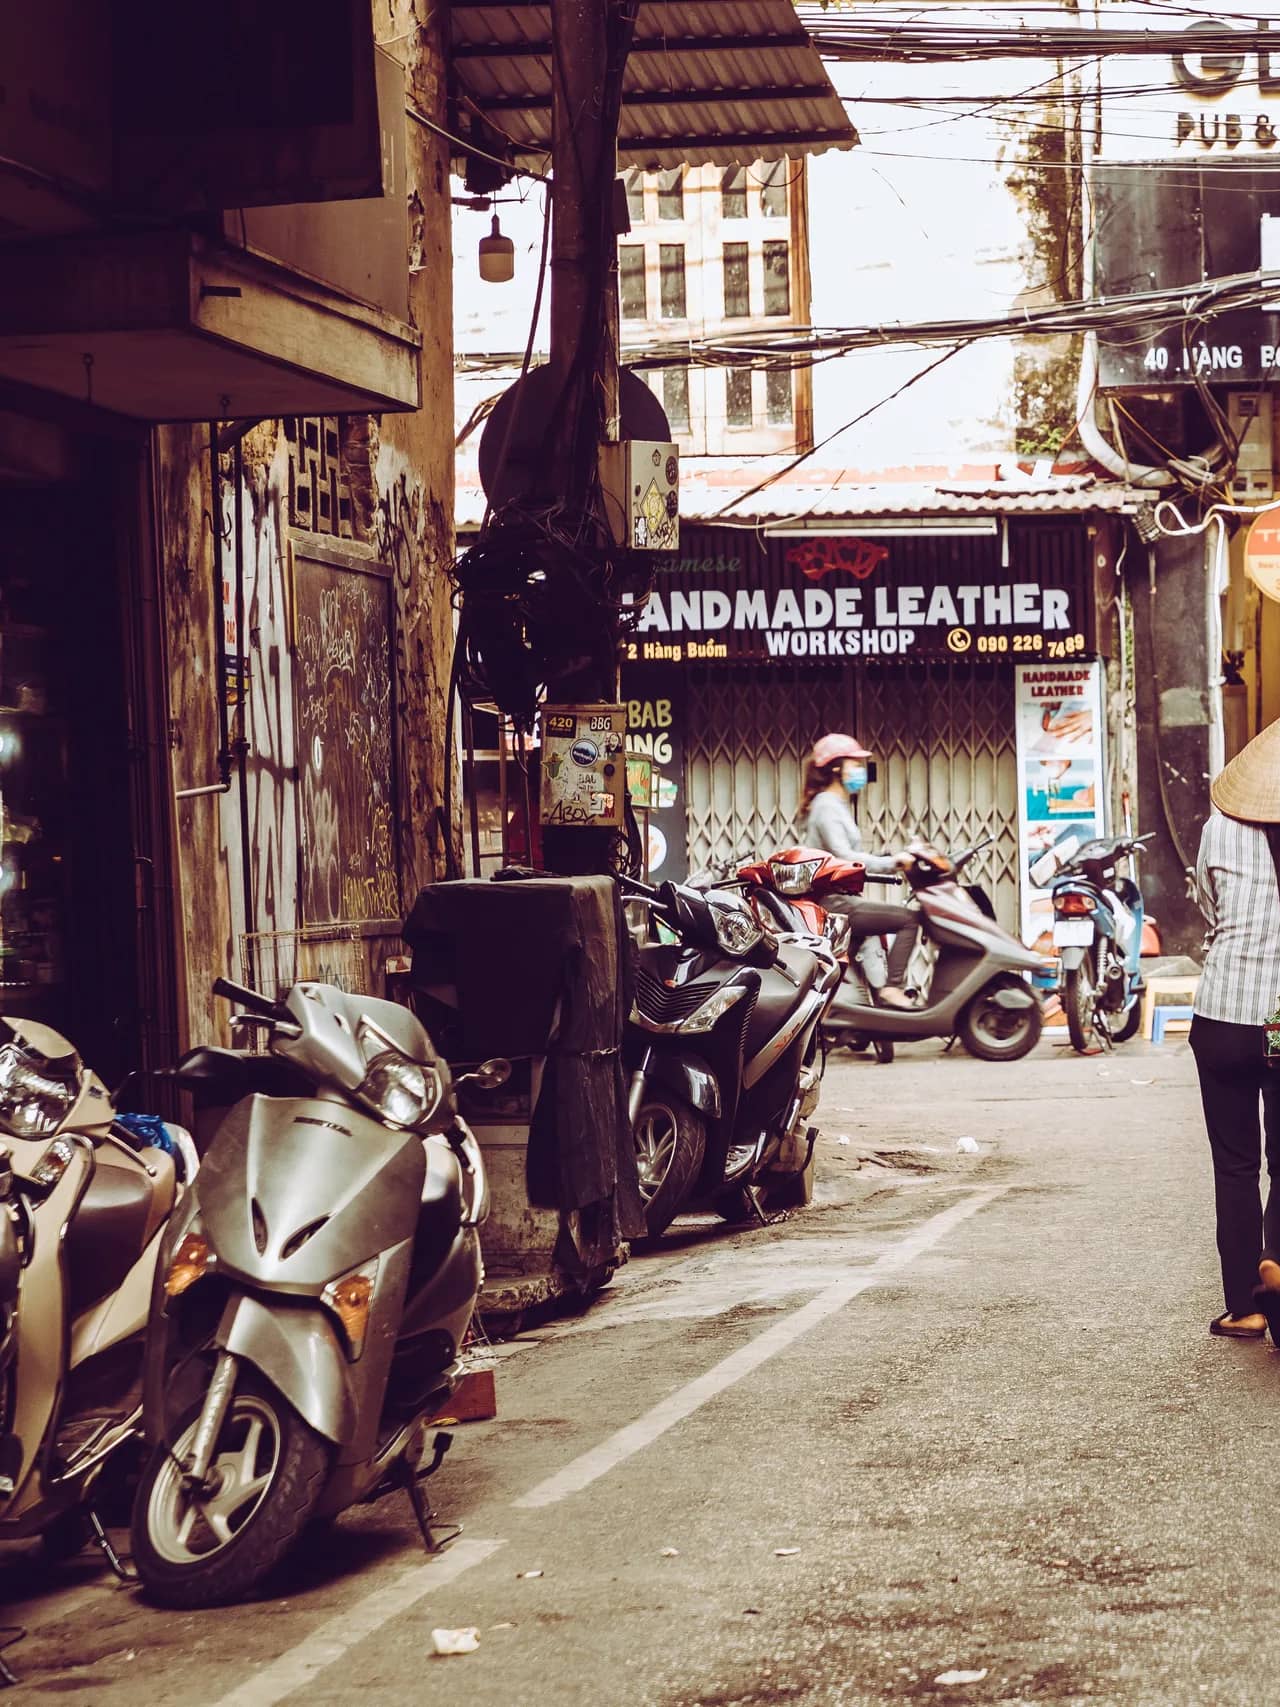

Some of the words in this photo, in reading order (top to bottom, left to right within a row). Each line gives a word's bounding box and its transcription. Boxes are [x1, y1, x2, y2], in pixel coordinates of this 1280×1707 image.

[1178, 111, 1242, 148] PUB
[1255, 114, 1277, 148] &
[1143, 347, 1169, 371] 40
[874, 583, 1072, 630] LEATHER
[643, 641, 681, 662] Hàng
[765, 629, 916, 656] WORKSHOP
[977, 636, 1008, 653] 090
[1012, 634, 1043, 651] 226
[1047, 633, 1085, 658] 7489
[1022, 670, 1090, 683] HANDMADE
[1031, 685, 1083, 697] LEATHER
[549, 716, 574, 728] 420
